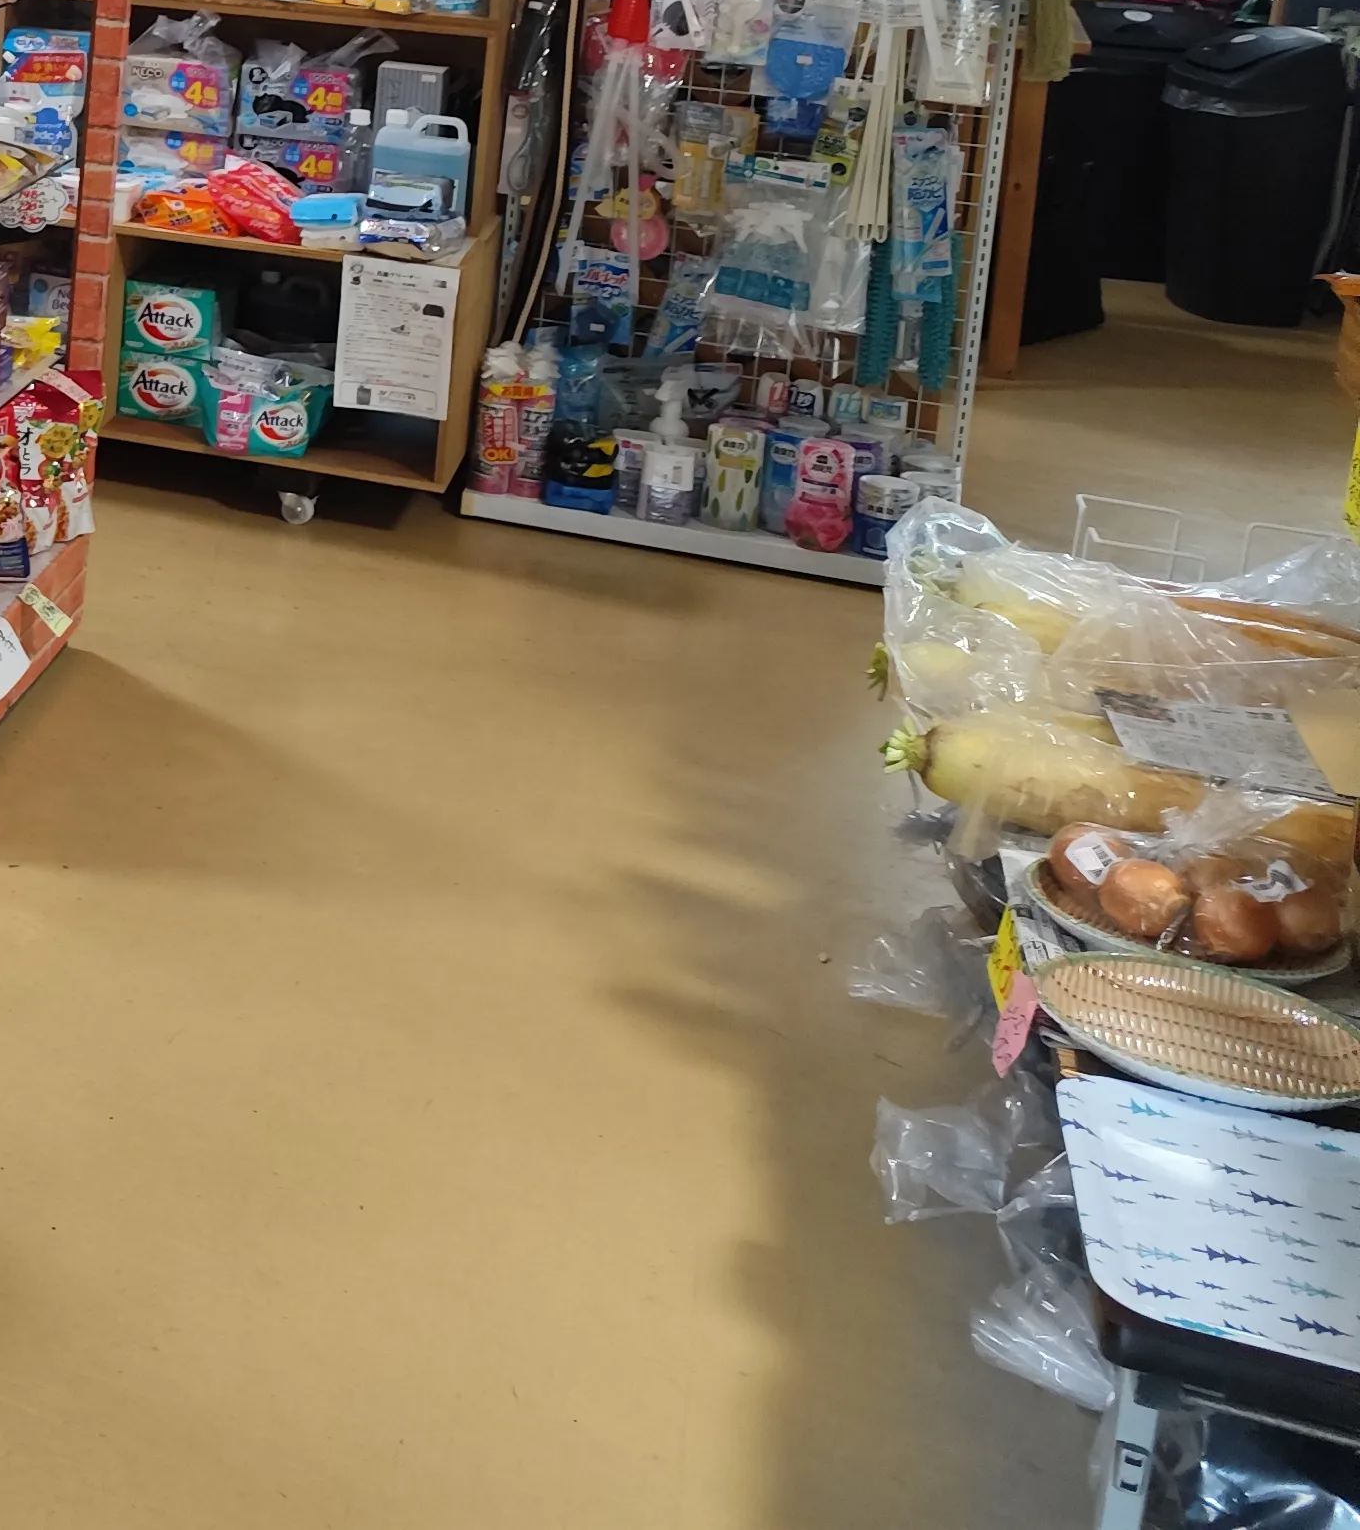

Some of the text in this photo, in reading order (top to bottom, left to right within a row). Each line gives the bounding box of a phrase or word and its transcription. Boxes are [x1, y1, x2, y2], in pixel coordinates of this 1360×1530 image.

[131, 66, 164, 80] NECO
[137, 302, 195, 332] Attack
[131, 370, 189, 400] Attack
[255, 408, 305, 431] Attack
